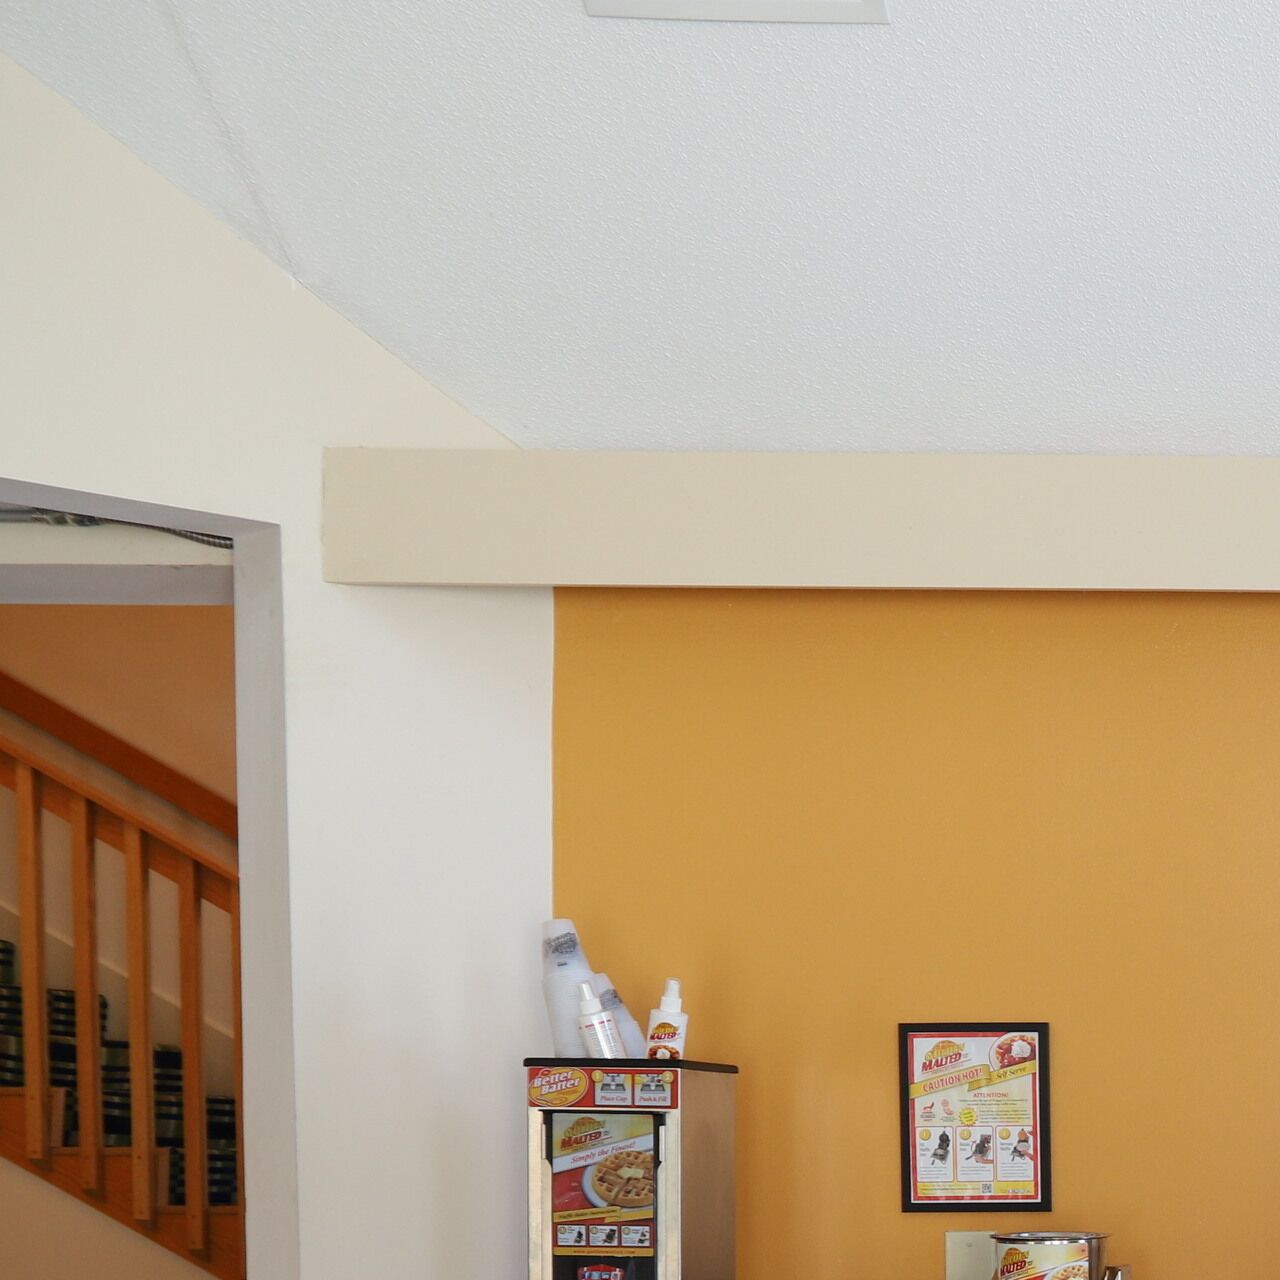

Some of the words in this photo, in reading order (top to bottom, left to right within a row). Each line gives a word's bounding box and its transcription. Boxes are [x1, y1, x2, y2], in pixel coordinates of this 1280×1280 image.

[650, 1032, 677, 1041] MALTED
[921, 1053, 962, 1072] MALTED
[533, 1070, 574, 1088] Better
[541, 1077, 580, 1095] Batter
[923, 1076, 961, 1092] CAUTION
[963, 1068, 983, 1081] HOT!
[560, 1131, 602, 1149] MALTED
[571, 1152, 597, 1165] Simply
[598, 1148, 609, 1157] the
